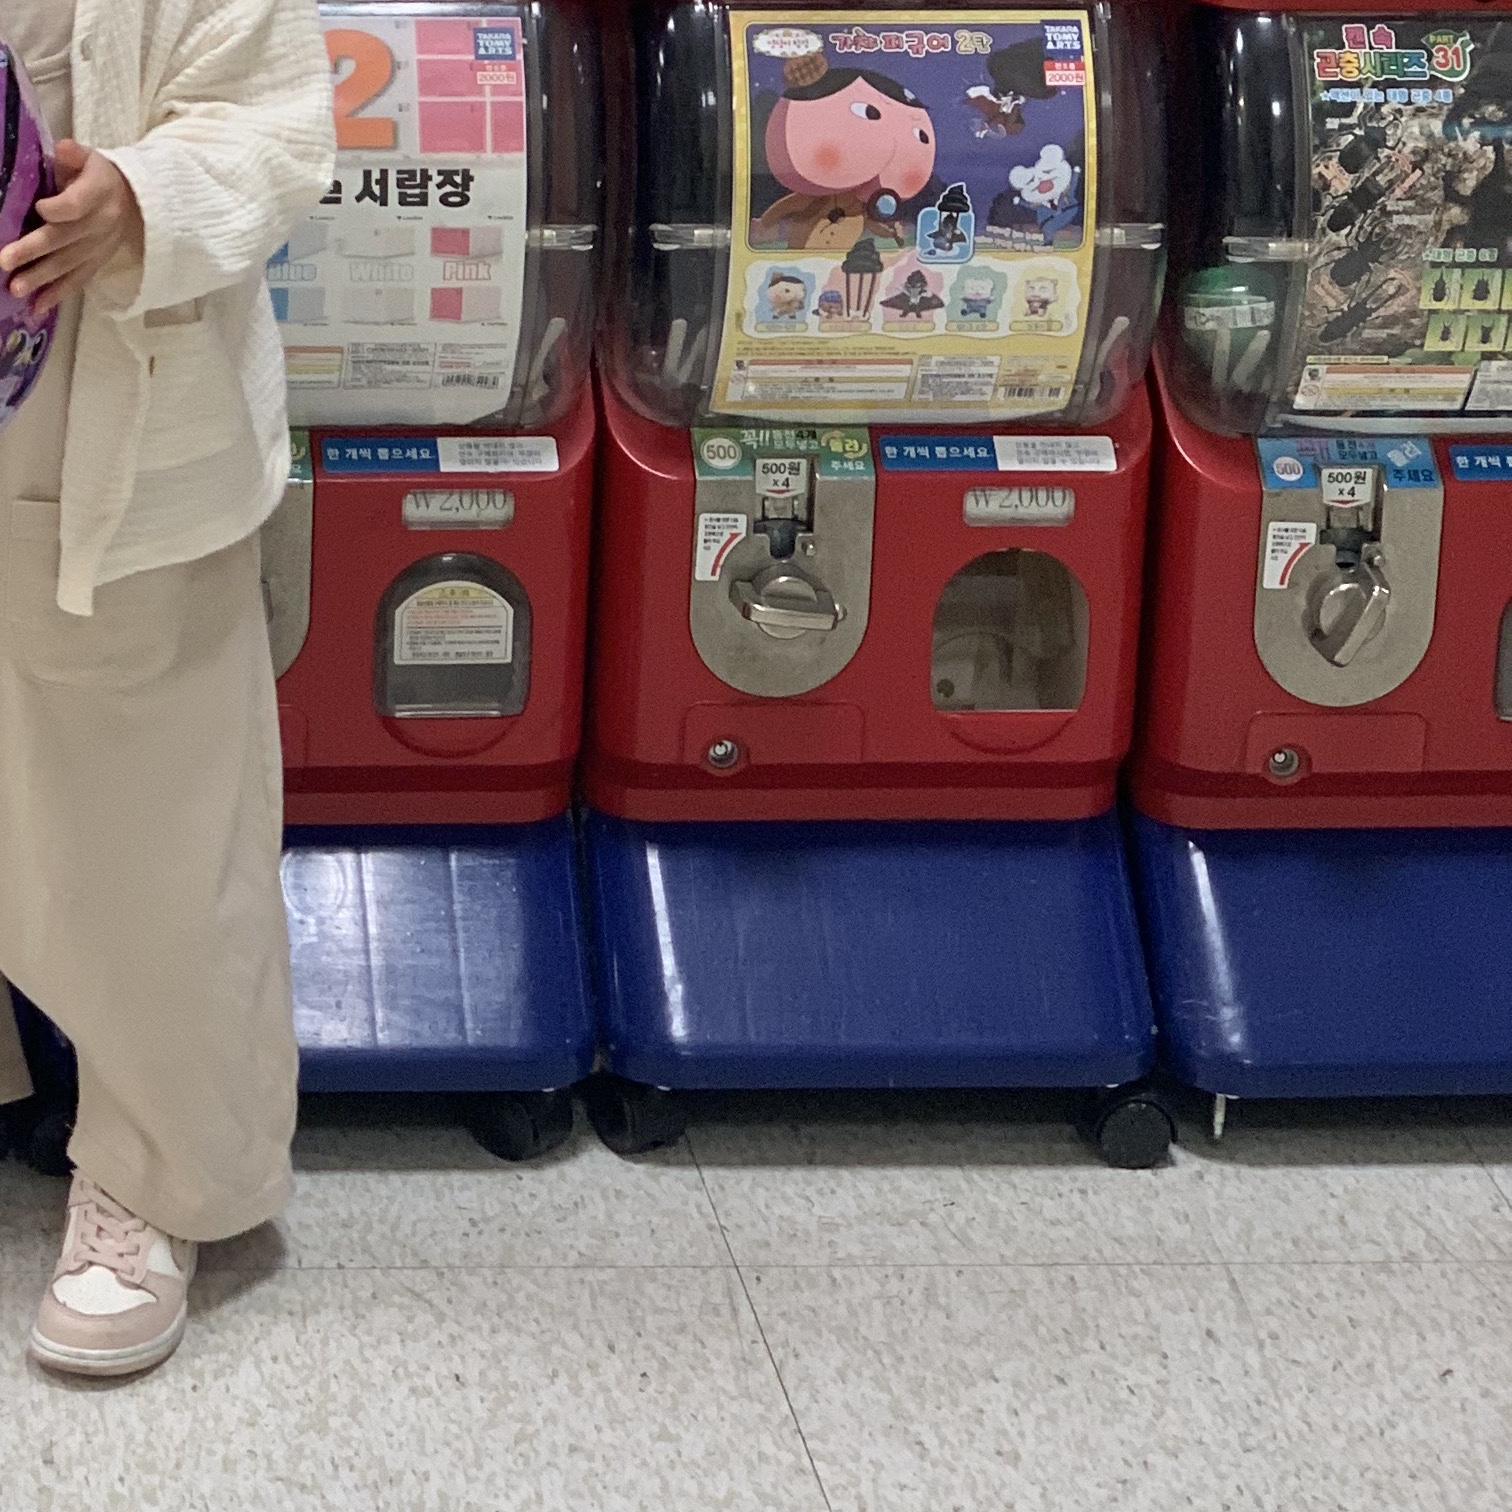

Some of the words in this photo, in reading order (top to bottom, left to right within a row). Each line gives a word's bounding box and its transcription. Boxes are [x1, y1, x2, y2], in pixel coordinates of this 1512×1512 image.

[1044, 25, 1080, 33] TAKARA
[476, 33, 512, 41] TAKARA
[476, 39, 512, 48] TOMY
[1044, 32, 1080, 42] TOMY
[1429, 34, 1454, 45] PART
[882, 32, 951, 57] 피규어
[1433, 45, 1464, 70] 31
[1316, 50, 1428, 80] 곤충시리즈
[477, 72, 516, 85] 2000원
[1048, 72, 1085, 84] 2000원
[354, 168, 476, 208] 서랍장
[442, 260, 492, 282] Pink
[326, 446, 342, 461] 한
[345, 446, 372, 461] 개씩
[705, 445, 738, 461] 500
[884, 445, 898, 459] 한
[903, 445, 930, 459] 개씩
[761, 461, 801, 476] 500원
[1273, 462, 1301, 476] 500
[1455, 455, 1470, 469] 한
[1474, 455, 1502, 469] 개씩
[1326, 470, 1367, 486] 500원
